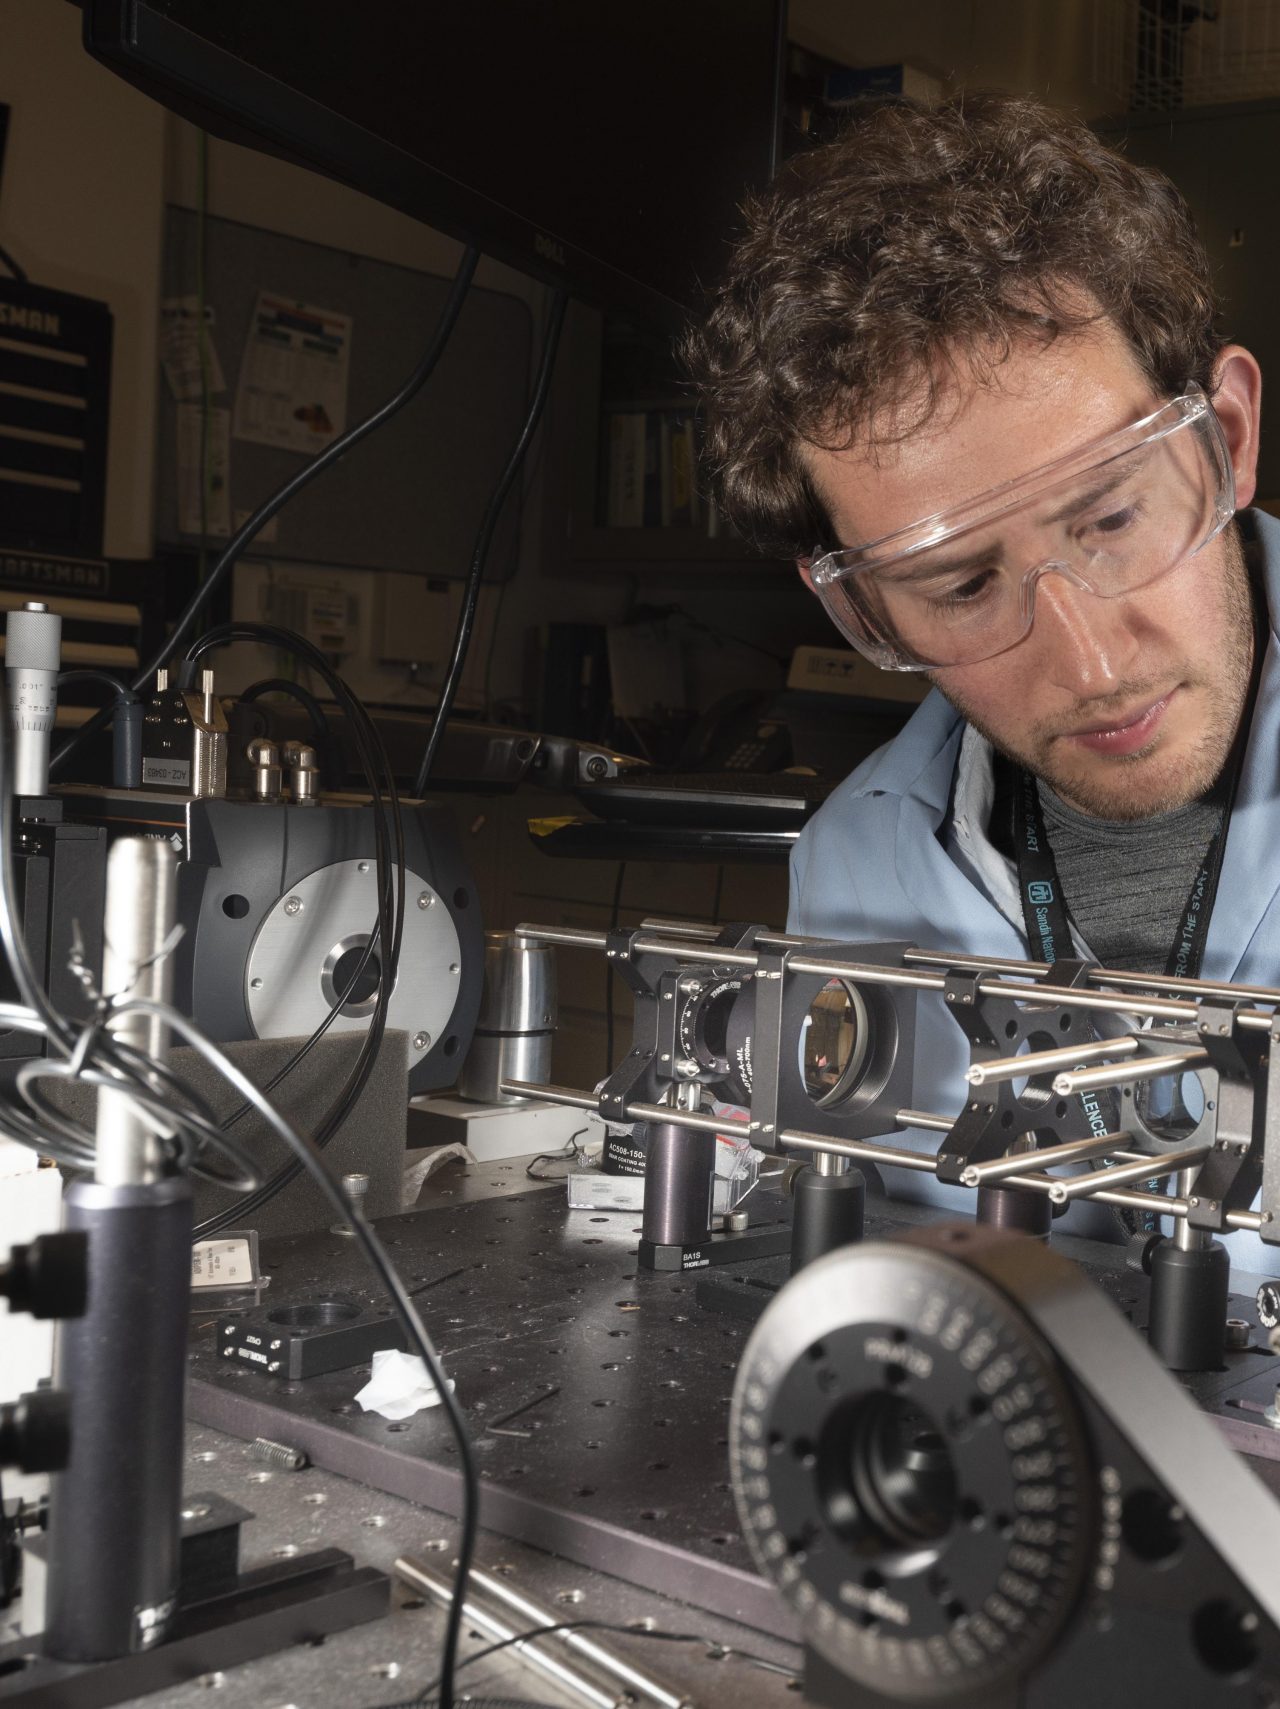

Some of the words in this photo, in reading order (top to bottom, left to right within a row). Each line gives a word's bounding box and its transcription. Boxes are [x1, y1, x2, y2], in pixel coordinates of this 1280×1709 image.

[0, 557, 101, 587] AFTSMAN
[1191, 870, 1209, 911] START
[1182, 912, 1198, 940] THE
[1174, 942, 1192, 979] FROM
[683, 1252, 701, 1261] BA1S
